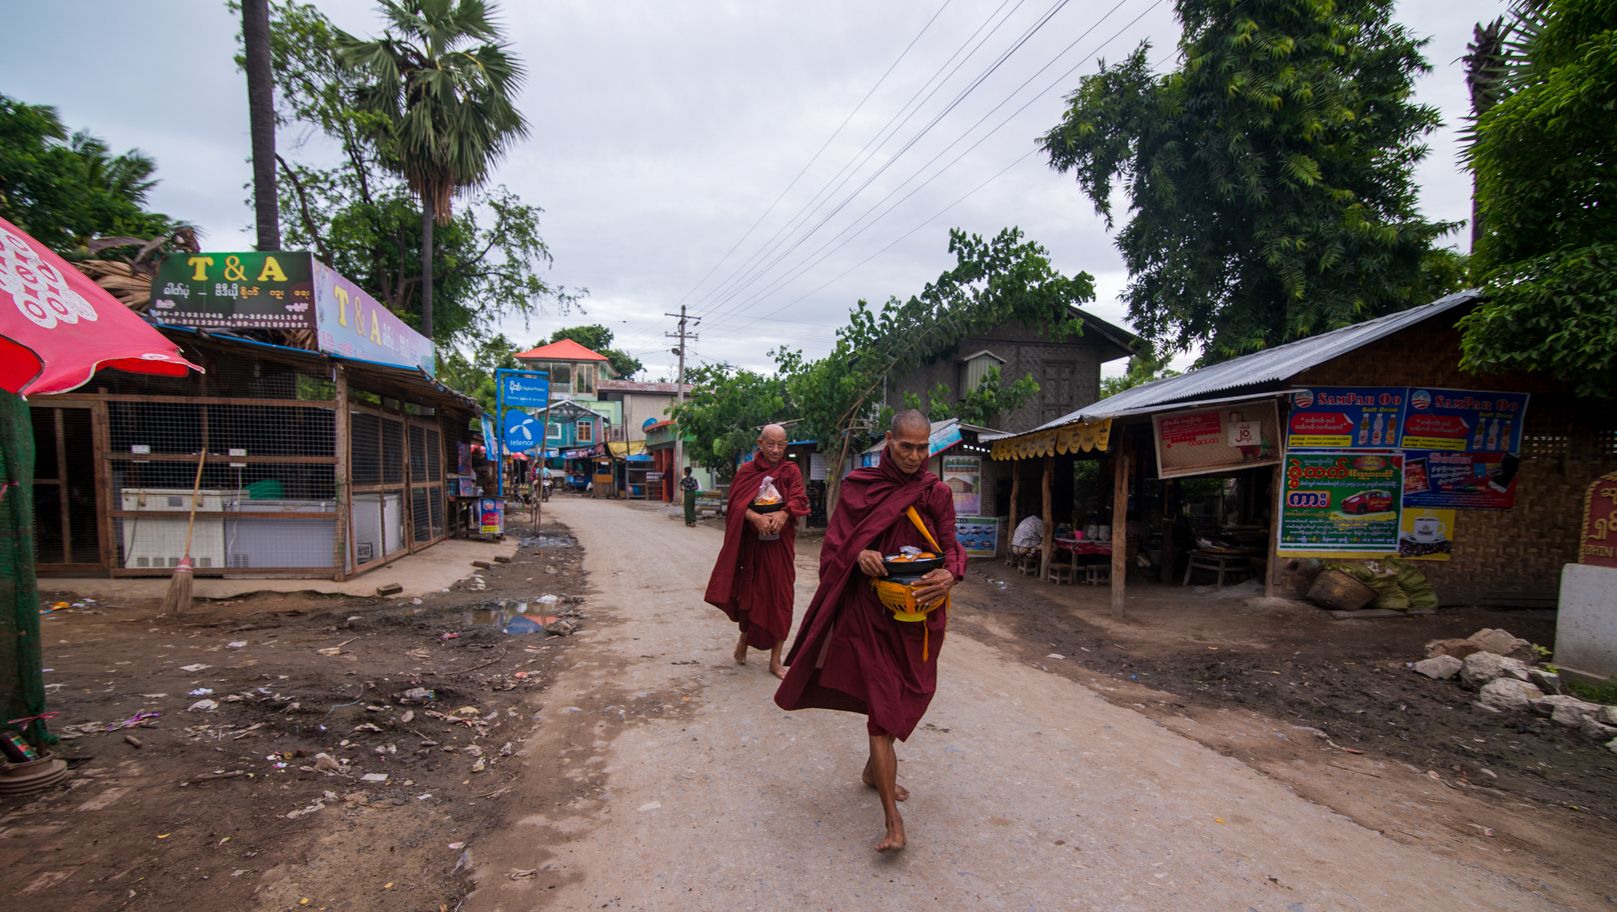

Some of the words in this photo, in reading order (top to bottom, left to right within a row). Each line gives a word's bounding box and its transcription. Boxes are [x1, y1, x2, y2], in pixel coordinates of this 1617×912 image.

[187, 256, 214, 281] T
[224, 256, 248, 282] &
[257, 256, 289, 282] A
[334, 284, 349, 328] T
[354, 295, 367, 337] &
[369, 308, 383, 346] A
[1288, 491, 1329, 508] ကား
[1584, 544, 1614, 558] SHIN
